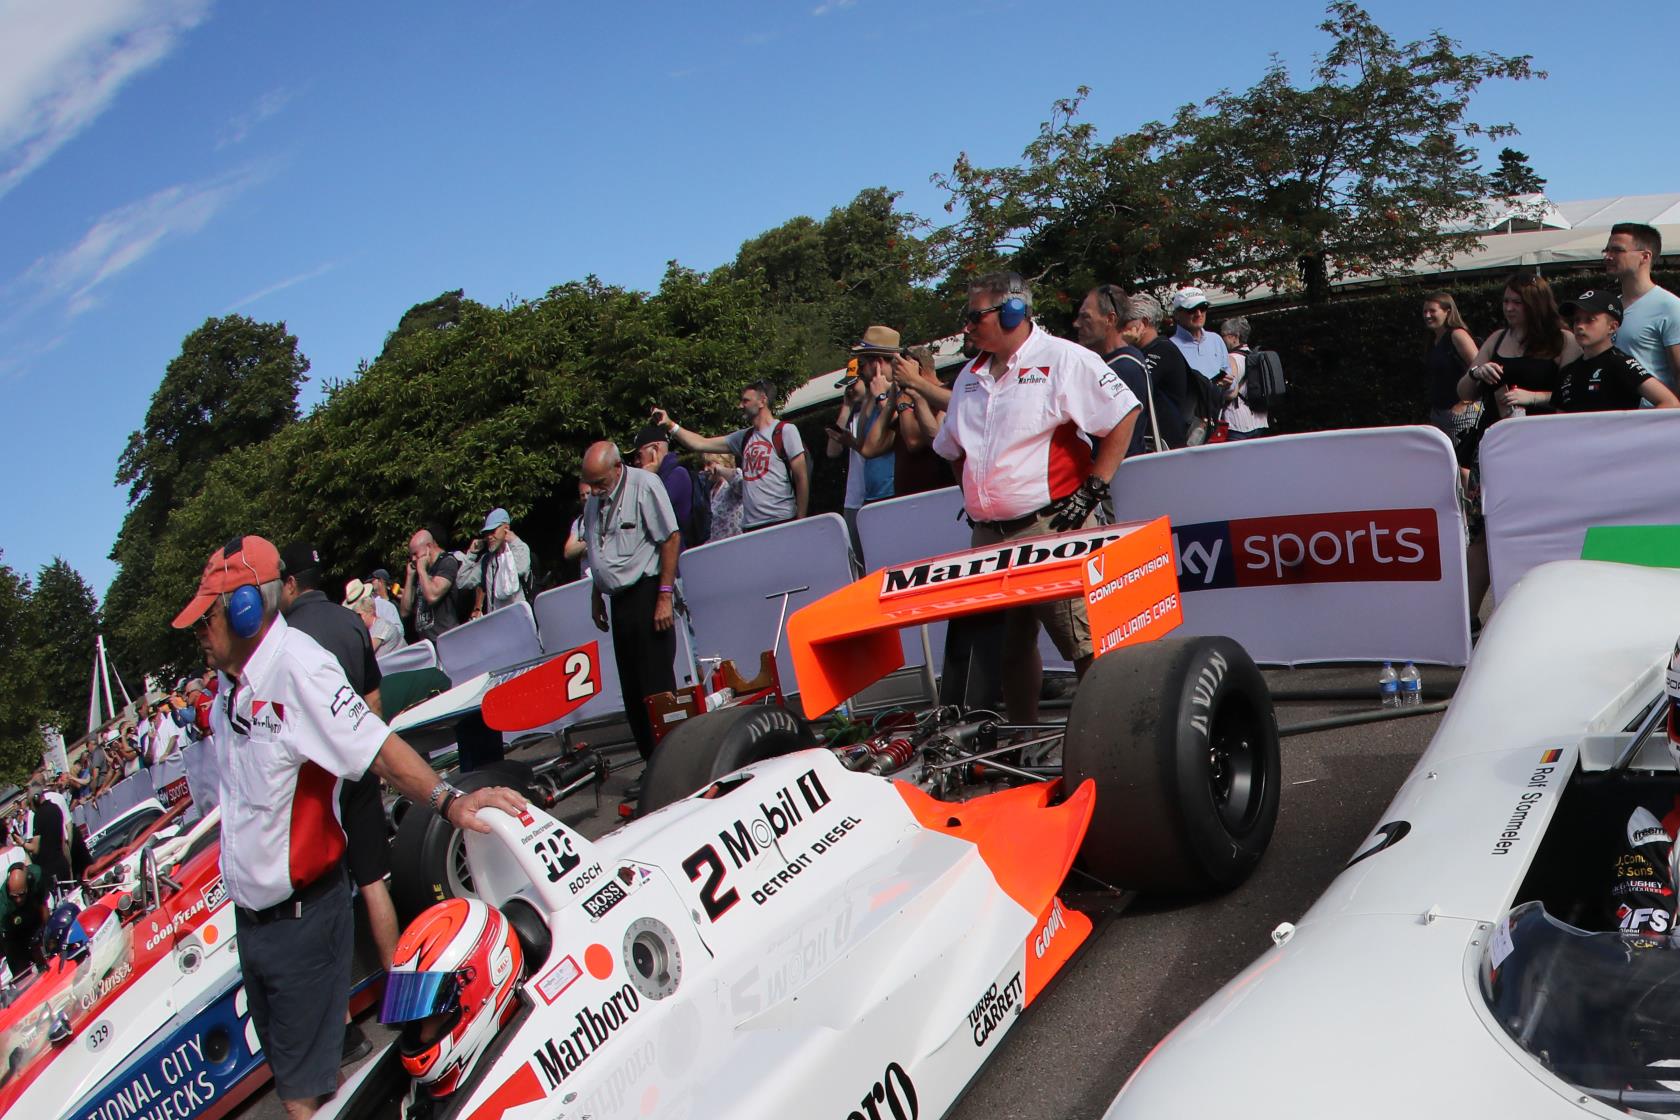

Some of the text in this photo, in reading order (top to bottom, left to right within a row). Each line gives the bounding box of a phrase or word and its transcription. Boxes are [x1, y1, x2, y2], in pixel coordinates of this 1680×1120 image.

[884, 534, 1120, 594] Marlbor
[1088, 552, 1170, 604] COMPUTERVISION
[1173, 521, 1425, 584] ky sports
[1153, 594, 1178, 621] CARS
[565, 651, 594, 701] 2
[719, 769, 832, 870] Mobil 1
[1491, 767, 1555, 855] Rolf Stommelen
[534, 829, 581, 883] PPG
[568, 862, 604, 895] BOSCH
[751, 816, 863, 906] DETROIT DIESEL
[1627, 864, 1654, 877] Sons
[585, 883, 621, 914] BOSS
[681, 843, 742, 924] 2
[146, 900, 205, 950] GOODYEAR
[967, 982, 997, 1028] TURBO
[973, 971, 1023, 1047] GARRETT
[91, 1025, 109, 1048] 329
[165, 1032, 206, 1086] CITY
[533, 984, 640, 1092] Marlboro
